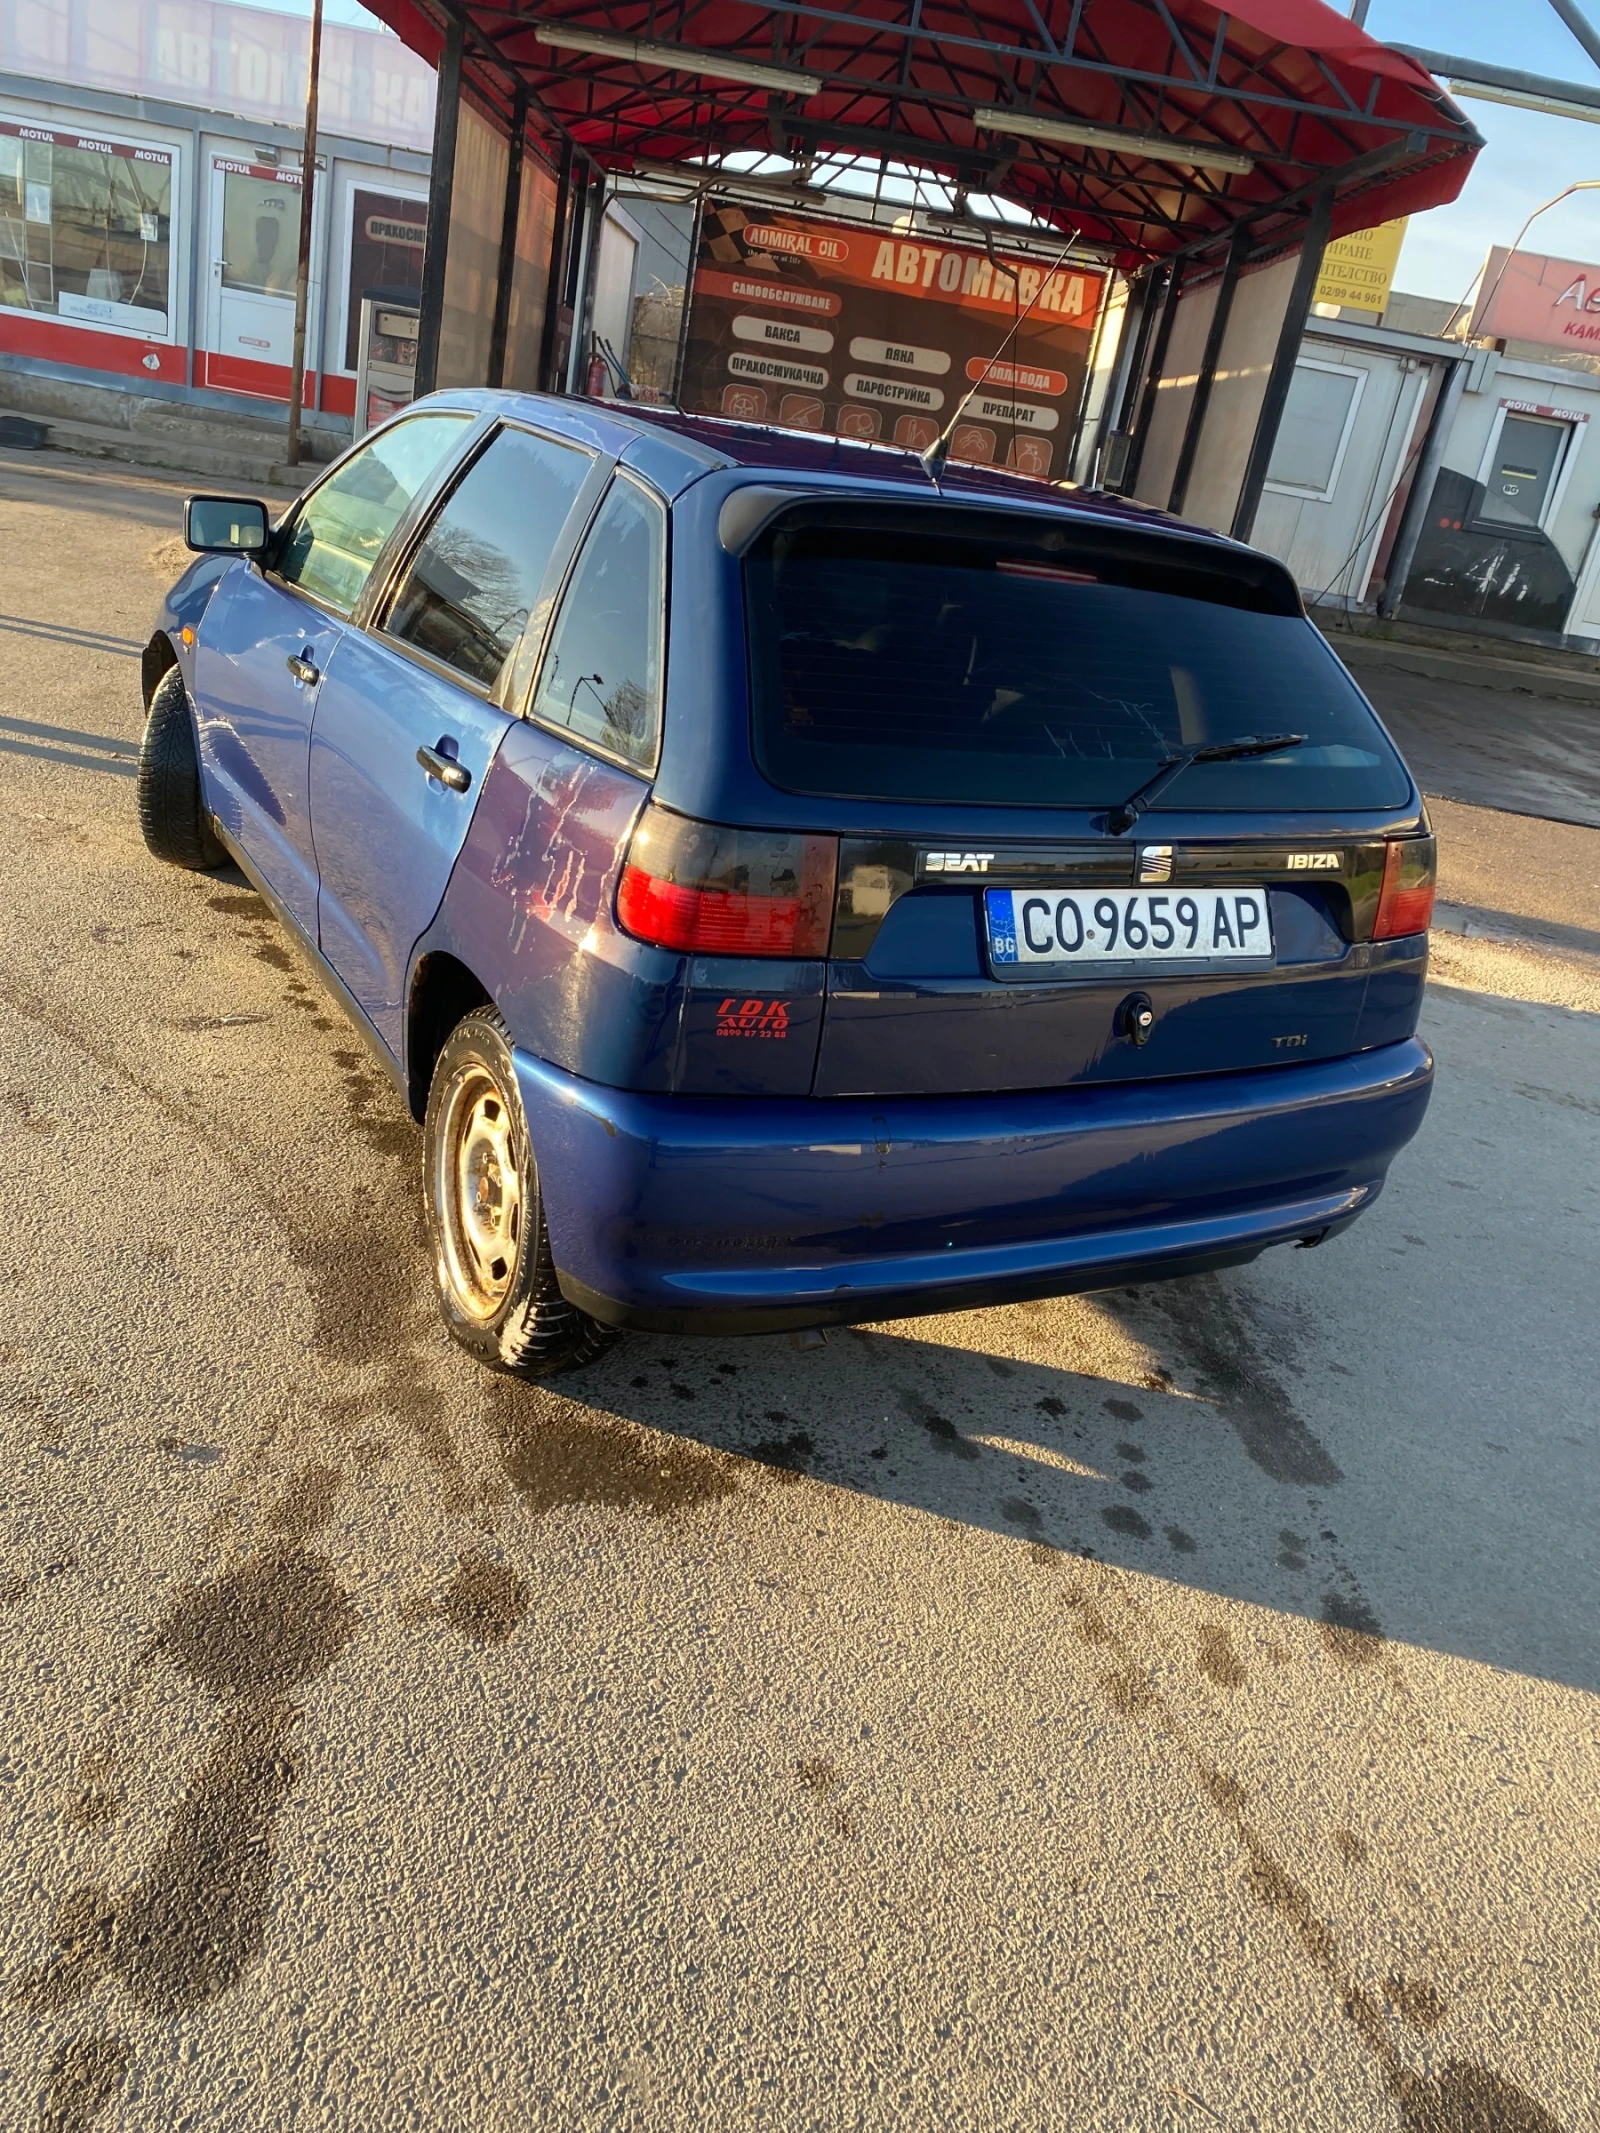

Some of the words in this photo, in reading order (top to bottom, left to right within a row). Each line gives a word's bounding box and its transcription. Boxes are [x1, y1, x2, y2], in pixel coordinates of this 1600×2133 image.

[19, 128, 54, 142] MOTUL
[78, 139, 113, 154] MOTUL
[134, 150, 169, 164] MOTUL
[216, 161, 250, 174] MOTUL
[370, 221, 425, 242] ПРАХОСМ
[750, 228, 812, 254] ADMIRAL
[819, 240, 839, 258] OIL
[871, 241, 1085, 316] АВТОМИВКА
[732, 281, 832, 310] САМООБСЛУЖВАНЕ
[1320, 285, 1347, 299] 02/99
[1349, 290, 1362, 300] 44
[1365, 292, 1382, 305] 961
[764, 325, 801, 343] ВАКСА
[885, 347, 914, 364] ПЯНА
[731, 357, 824, 385] ПРАХОСМУКАЧКА
[1019, 371, 1050, 389] ВОДА
[856, 379, 931, 404] ПАРОСТРУЙКА
[982, 402, 1036, 422] ПРЕПАРАТ
[1504, 400, 1538, 413] MOTUL
[1551, 409, 1585, 421] MOTUL
[925, 852, 995, 872] SEAT
[1287, 853, 1340, 869] IBIZA
[1022, 897, 1085, 954] CO
[1094, 896, 1200, 952] 9659
[1212, 896, 1260, 949] AP
[995, 937, 1015, 954] BG
[716, 1029, 742, 1037] 0899
[759, 1030, 772, 1038] 22
